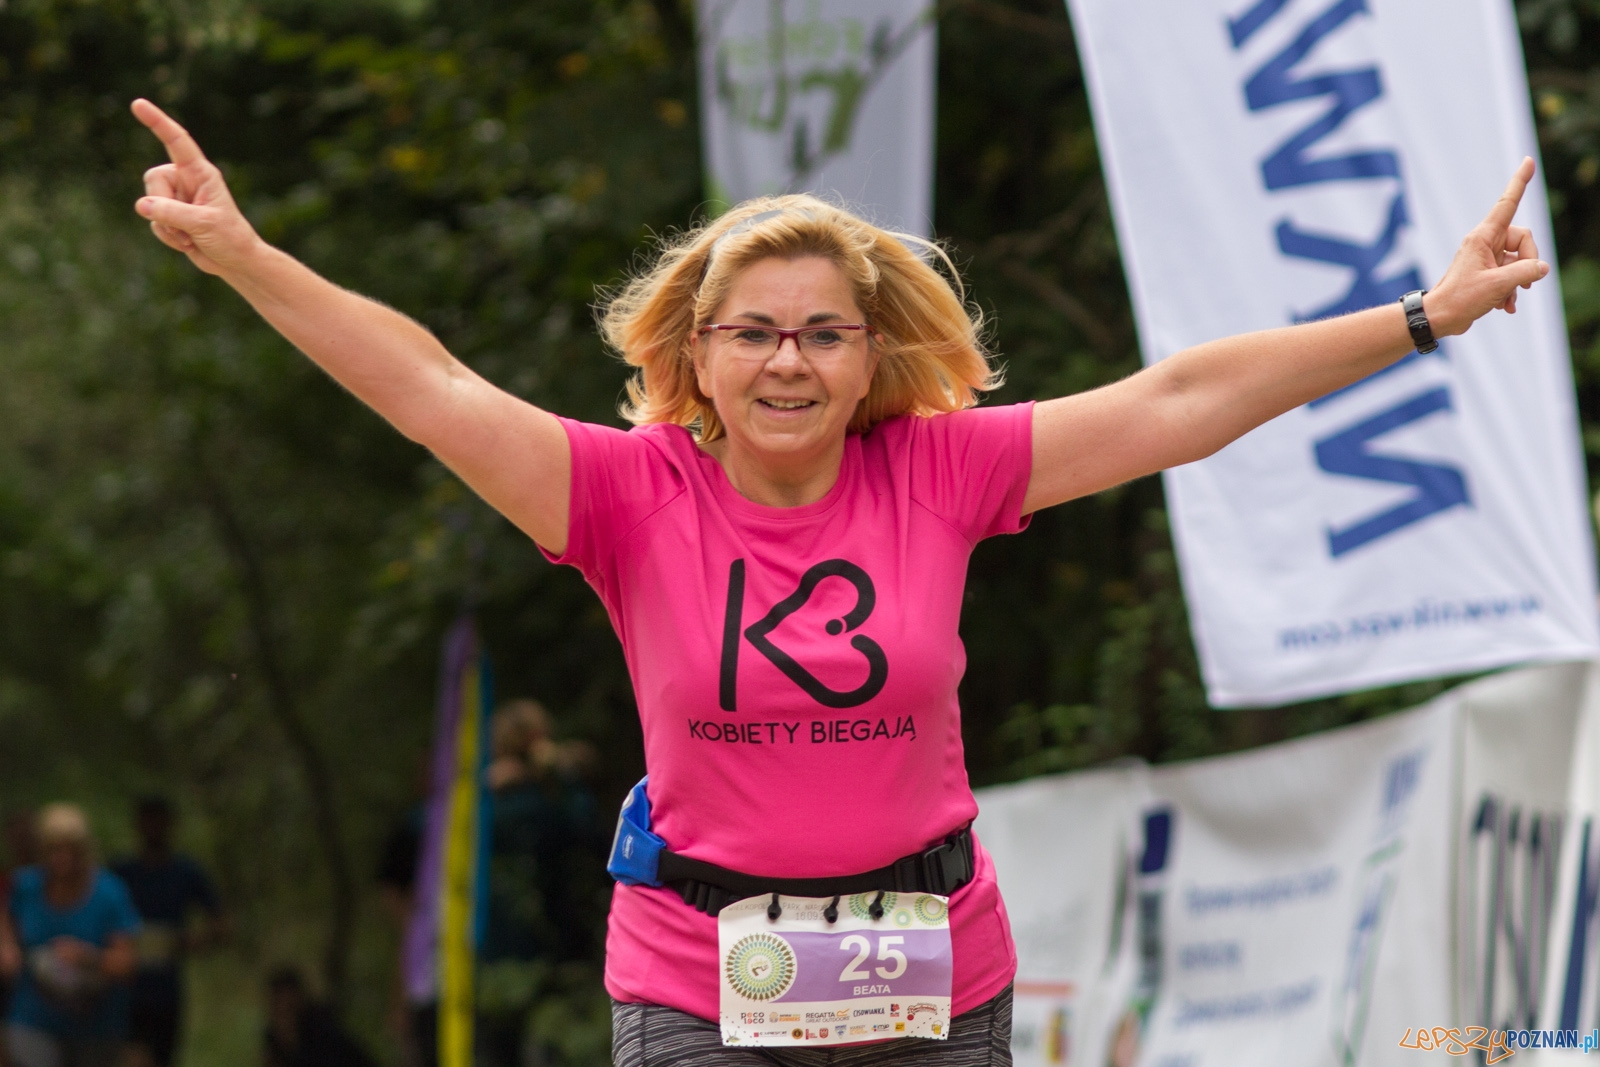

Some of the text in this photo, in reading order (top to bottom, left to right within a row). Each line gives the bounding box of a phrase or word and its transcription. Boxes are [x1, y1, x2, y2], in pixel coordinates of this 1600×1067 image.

[688, 715, 917, 744] KOBIETY BIEGAJĄ
[839, 934, 908, 982] 25
[853, 984, 891, 996] BEATA
[805, 1011, 836, 1019] REGATTA
[853, 1007, 885, 1017] CISOWIANKA
